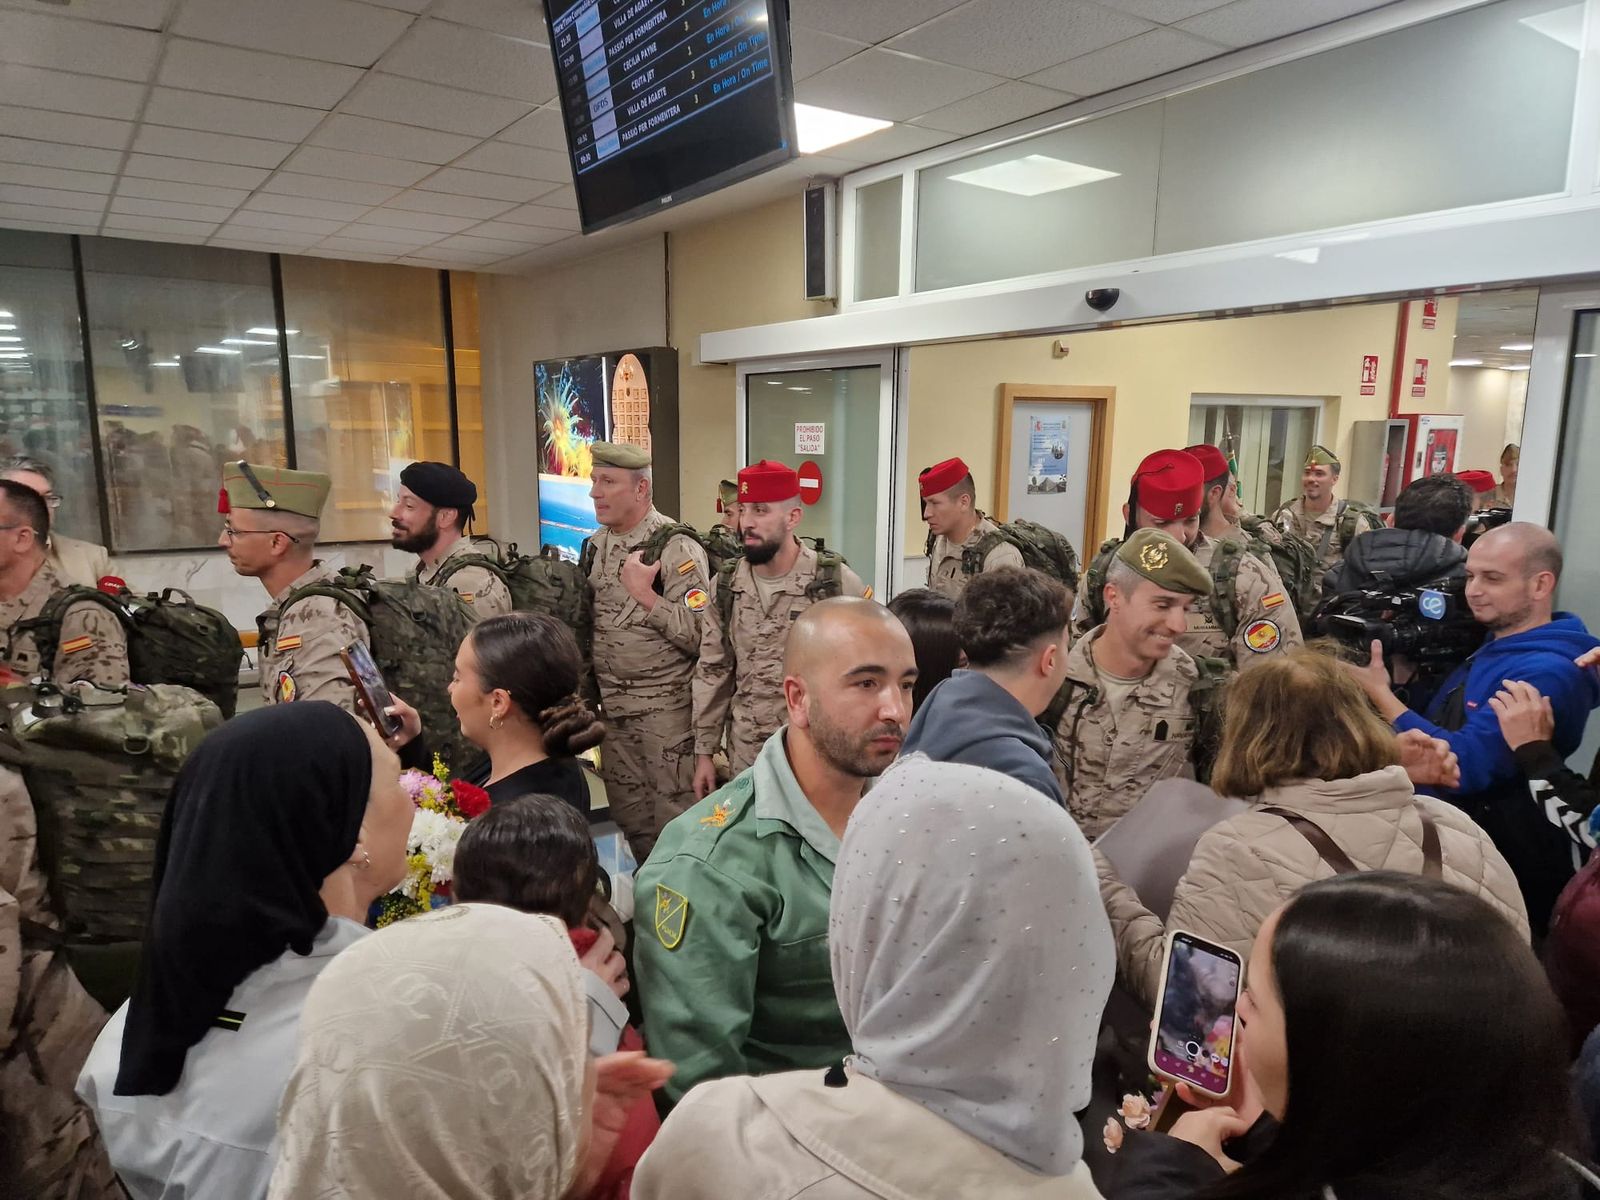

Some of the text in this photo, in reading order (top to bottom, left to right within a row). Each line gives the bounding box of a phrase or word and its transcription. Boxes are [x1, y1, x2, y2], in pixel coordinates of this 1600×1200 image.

[613, 13, 627, 29] VILLA
[627, 7, 634, 20] DE
[625, 32, 635, 46] PER
[634, 9, 668, 40] FORMENTERA
[623, 54, 641, 72] CECILIA
[641, 42, 657, 60] PAYNE
[684, 21, 689, 31] 3
[703, 8, 711, 18] En
[631, 74, 647, 90] CEUTA
[646, 68, 655, 83] JET
[688, 46, 692, 56] 1
[706, 33, 715, 44] En
[715, 23, 730, 39] Hora
[627, 102, 640, 116] VILLA
[640, 97, 648, 108] DE
[648, 86, 667, 104] AGAETE
[691, 70, 695, 80] 3
[710, 58, 718, 69] En
[718, 50, 733, 64] Hora
[738, 42, 747, 52] On
[638, 122, 648, 134] PER
[648, 104, 681, 128] FORMENTERA
[694, 94, 699, 104] 3
[713, 84, 721, 94] En
[722, 75, 737, 89] Hora
[741, 68, 751, 79] On
[751, 59, 768, 72] Time
[796, 425, 824, 433] PROHIBIDO
[799, 434, 820, 442] EL PASO
[798, 444, 820, 452] "SALIDA"
